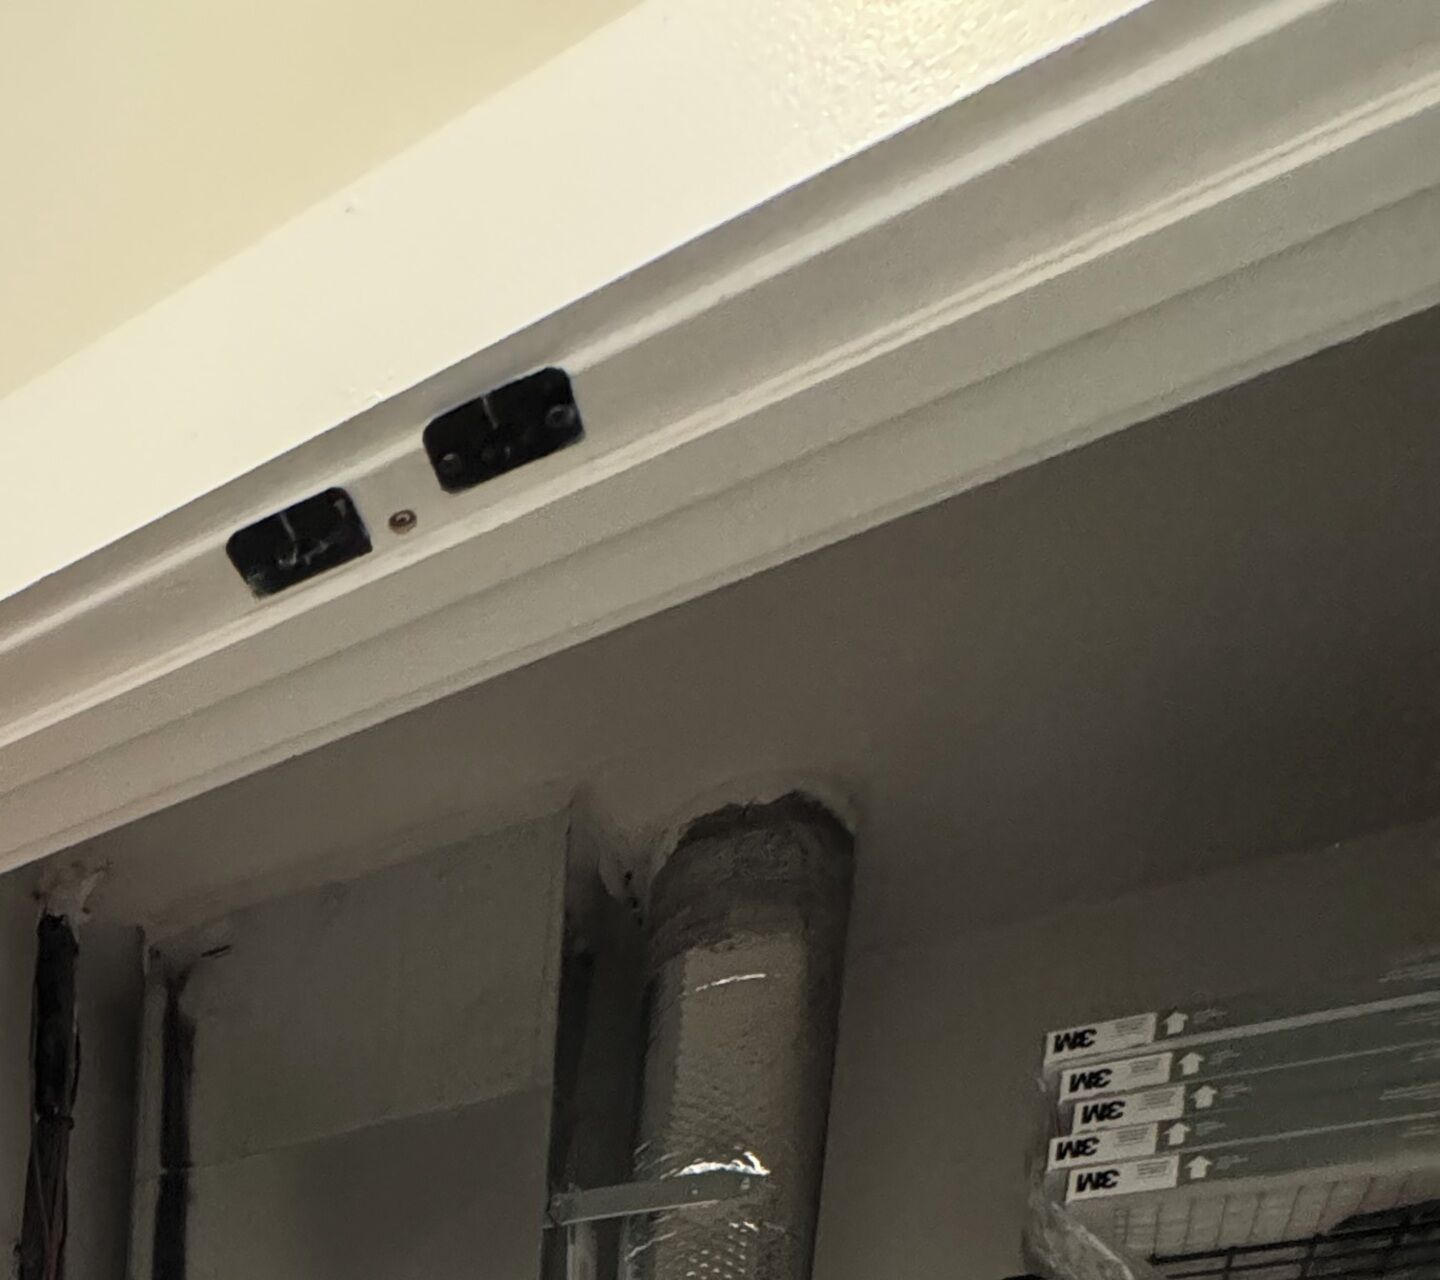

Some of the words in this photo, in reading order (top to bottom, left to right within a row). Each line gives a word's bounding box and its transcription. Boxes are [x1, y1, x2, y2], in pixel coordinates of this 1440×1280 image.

[1053, 1028, 1097, 1053] 3M
[1069, 1068, 1112, 1094] 3M
[1081, 1101, 1125, 1125] 3M
[1056, 1137, 1100, 1161] 3M
[1076, 1169, 1120, 1194] 3M
